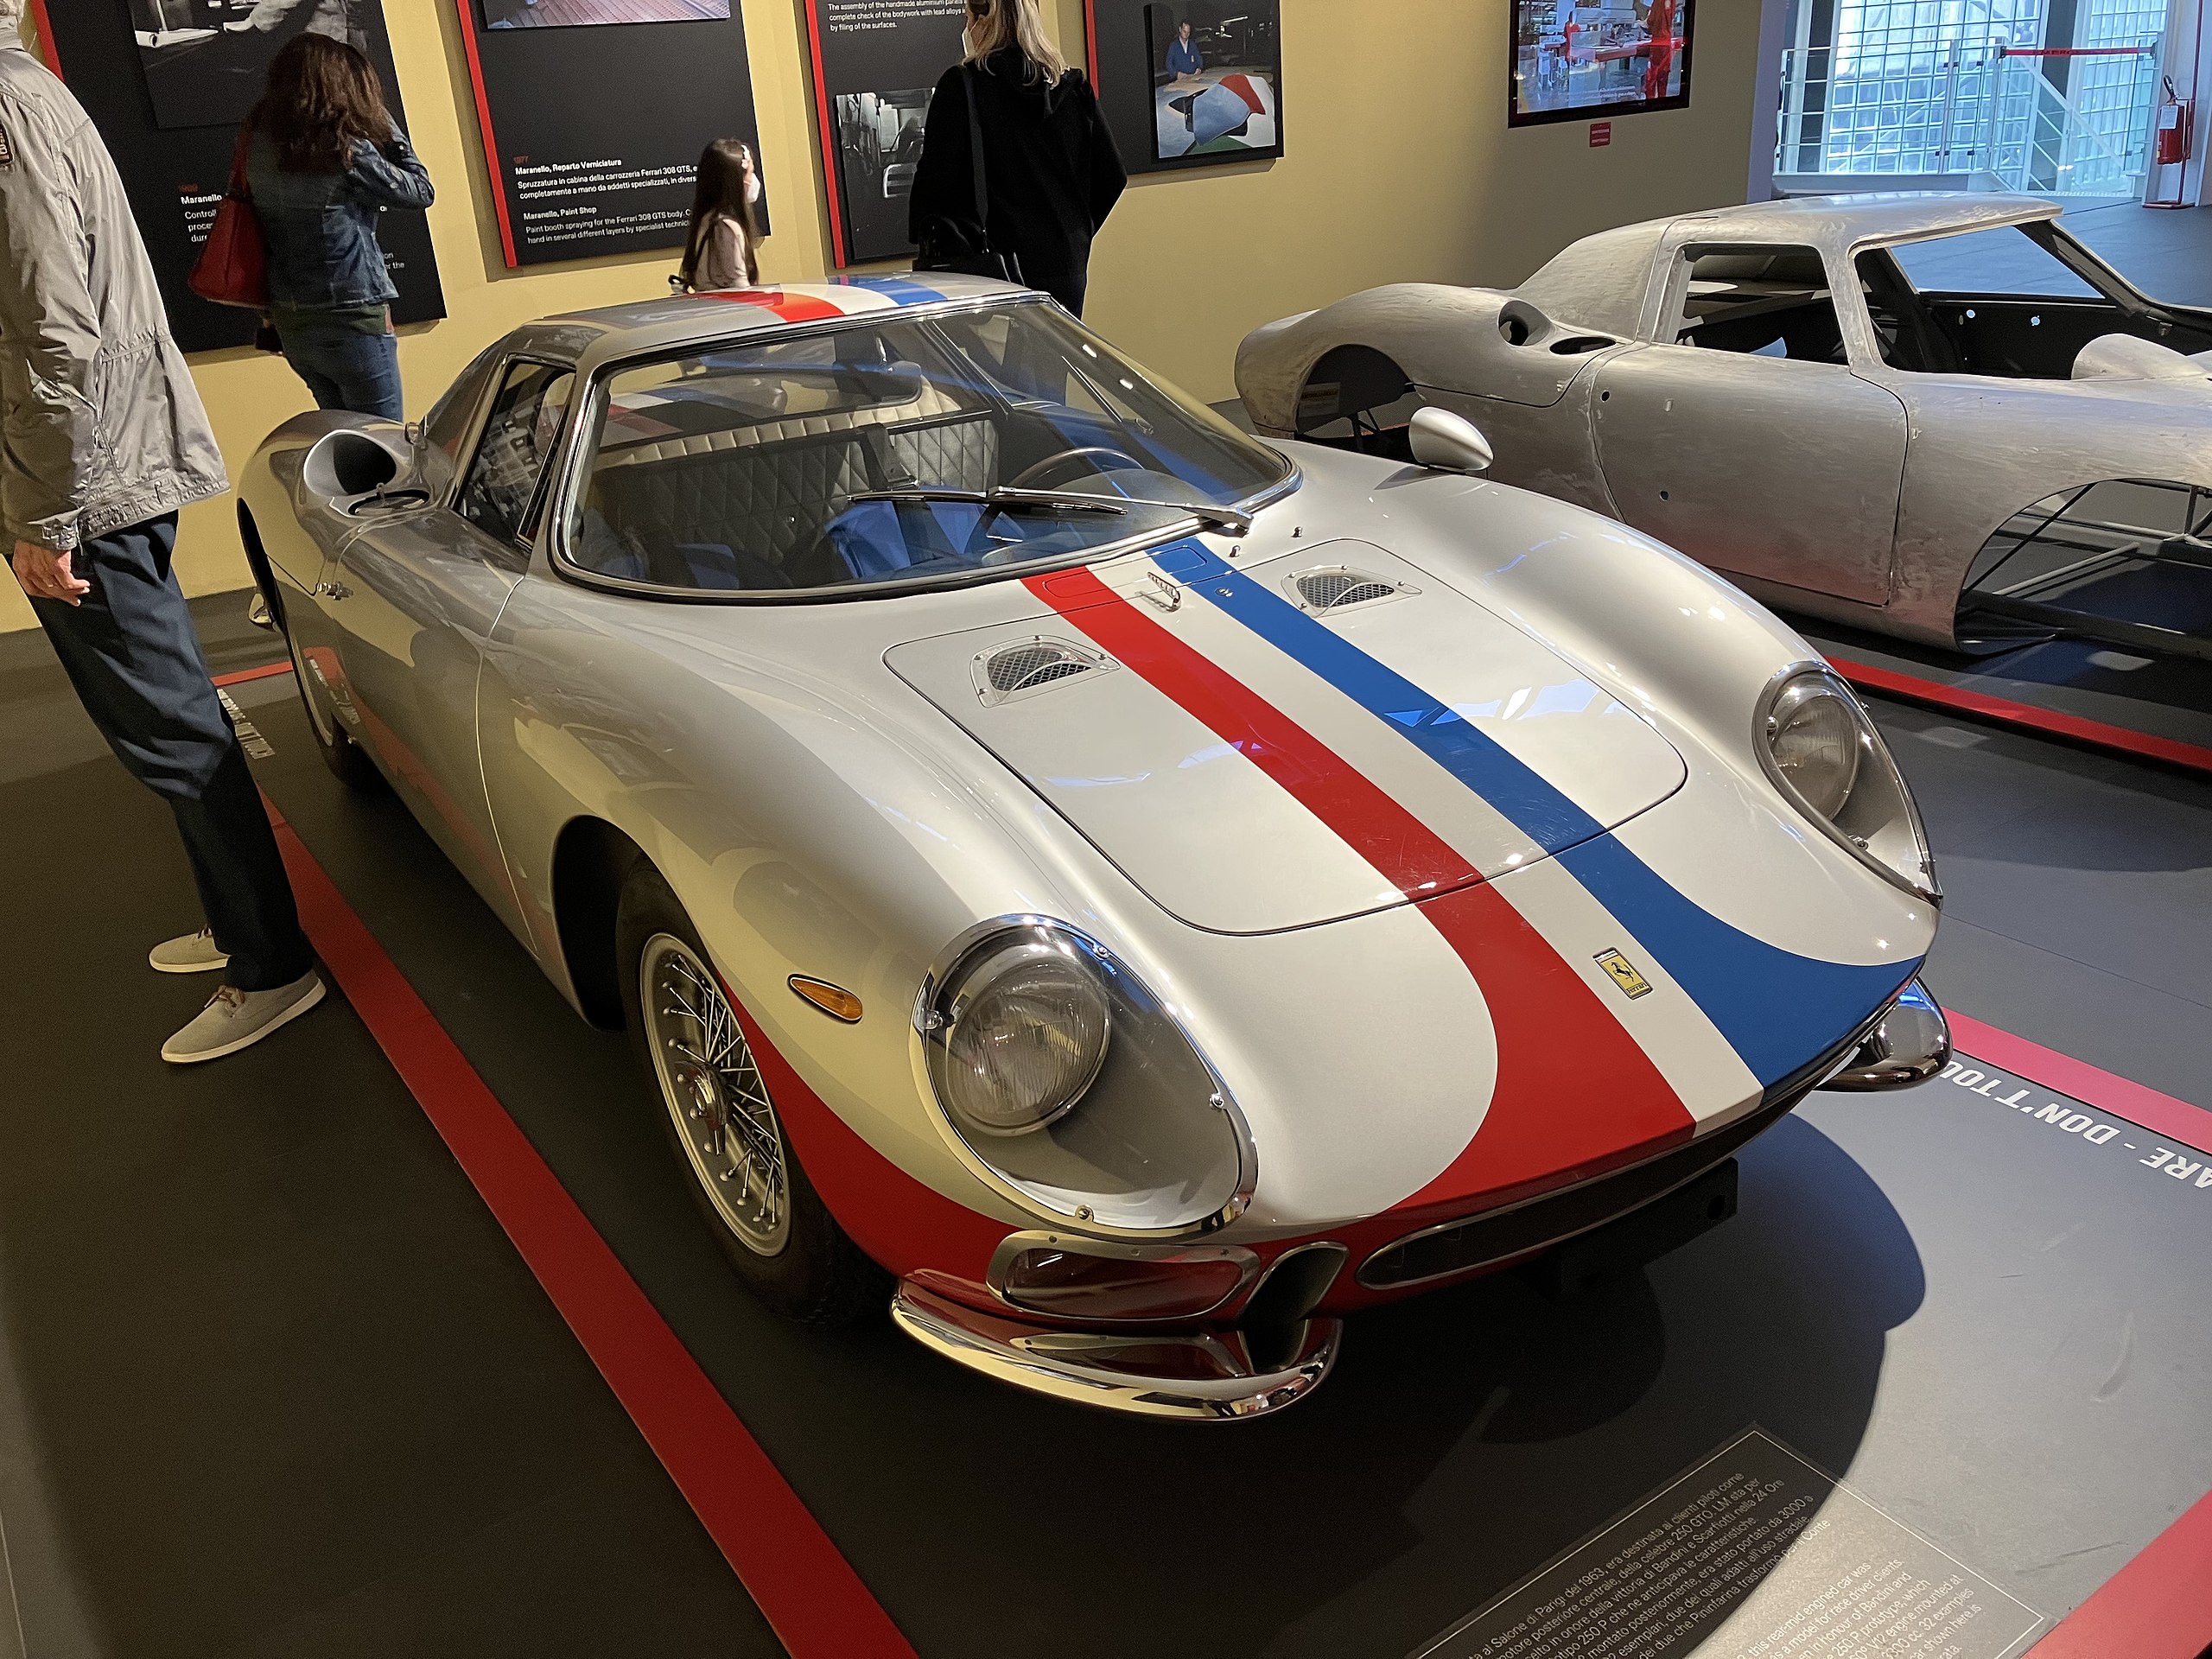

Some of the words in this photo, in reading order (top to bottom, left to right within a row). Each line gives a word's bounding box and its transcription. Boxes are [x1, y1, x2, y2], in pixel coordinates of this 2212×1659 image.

[1993, 1089, 2121, 1145] DON'T
[1482, 1643, 1494, 1656] al
[1491, 1623, 1528, 1648] Salone
[1526, 1613, 1539, 1624] di
[1535, 1594, 1567, 1618] Parigi
[1564, 1583, 1582, 1598] del
[1578, 1567, 1609, 1586] 1963,
[1605, 1556, 1624, 1569] era
[1621, 1528, 1664, 1559] destinata
[1662, 1520, 1674, 1530] ai
[1671, 1503, 1700, 1523] clienti
[1696, 1489, 1720, 1508] piloti
[1718, 1473, 1744, 1491] come
[1530, 1604, 1580, 1642] posteriore
[1579, 1578, 1622, 1606] centrale,
[1618, 1561, 1643, 1579] della
[1640, 1538, 1675, 1563] celebre
[1670, 1524, 1693, 1541] 250
[1711, 1497, 1732, 1511] LM
[1730, 1489, 1746, 1501] sta
[1744, 1478, 1766, 1494] per
[1547, 1637, 1562, 1646] in
[1560, 1616, 1591, 1638] onore
[1588, 1600, 1613, 1618] della
[1610, 1578, 1646, 1602] vittoria
[1643, 1569, 1656, 1580] di
[1651, 1545, 1690, 1573] Bandini
[1692, 1512, 1737, 1543] Scarfiotti
[1733, 1499, 1757, 1516] nella
[1751, 1490, 1768, 1502] 24
[1764, 1479, 1784, 1492] Ore
[1577, 1626, 1600, 1645] 250
[1597, 1619, 1607, 1630] P
[1609, 1608, 1629, 1624] che
[1626, 1599, 1643, 1611] ne
[1640, 1567, 1688, 1601] anticipava
[1682, 1560, 1697, 1569] le
[1586, 1627, 1630, 1659] montato
[1627, 1578, 1702, 1631] posteriormente,
[1698, 1566, 1716, 1578] era
[1713, 1548, 1738, 1567] stato
[1736, 1526, 1770, 1553] portato
[1768, 1517, 1783, 1528] da
[1777, 1498, 1806, 1519] 3000
[1618, 1619, 1669, 1659] esemplari,
[1665, 1606, 1687, 1622] due
[1683, 1592, 1701, 1608] dei
[1699, 1577, 1724, 1597] quali
[1720, 1560, 1750, 1581] adatti
[1747, 1541, 1777, 1562] all'uso
[1654, 1634, 1675, 1650] due
[1673, 1620, 1694, 1636] che
[1688, 1586, 1741, 1624] Pininfarina
[1736, 1554, 1783, 1588] trasformò
[1800, 1520, 1831, 1541] Conte
